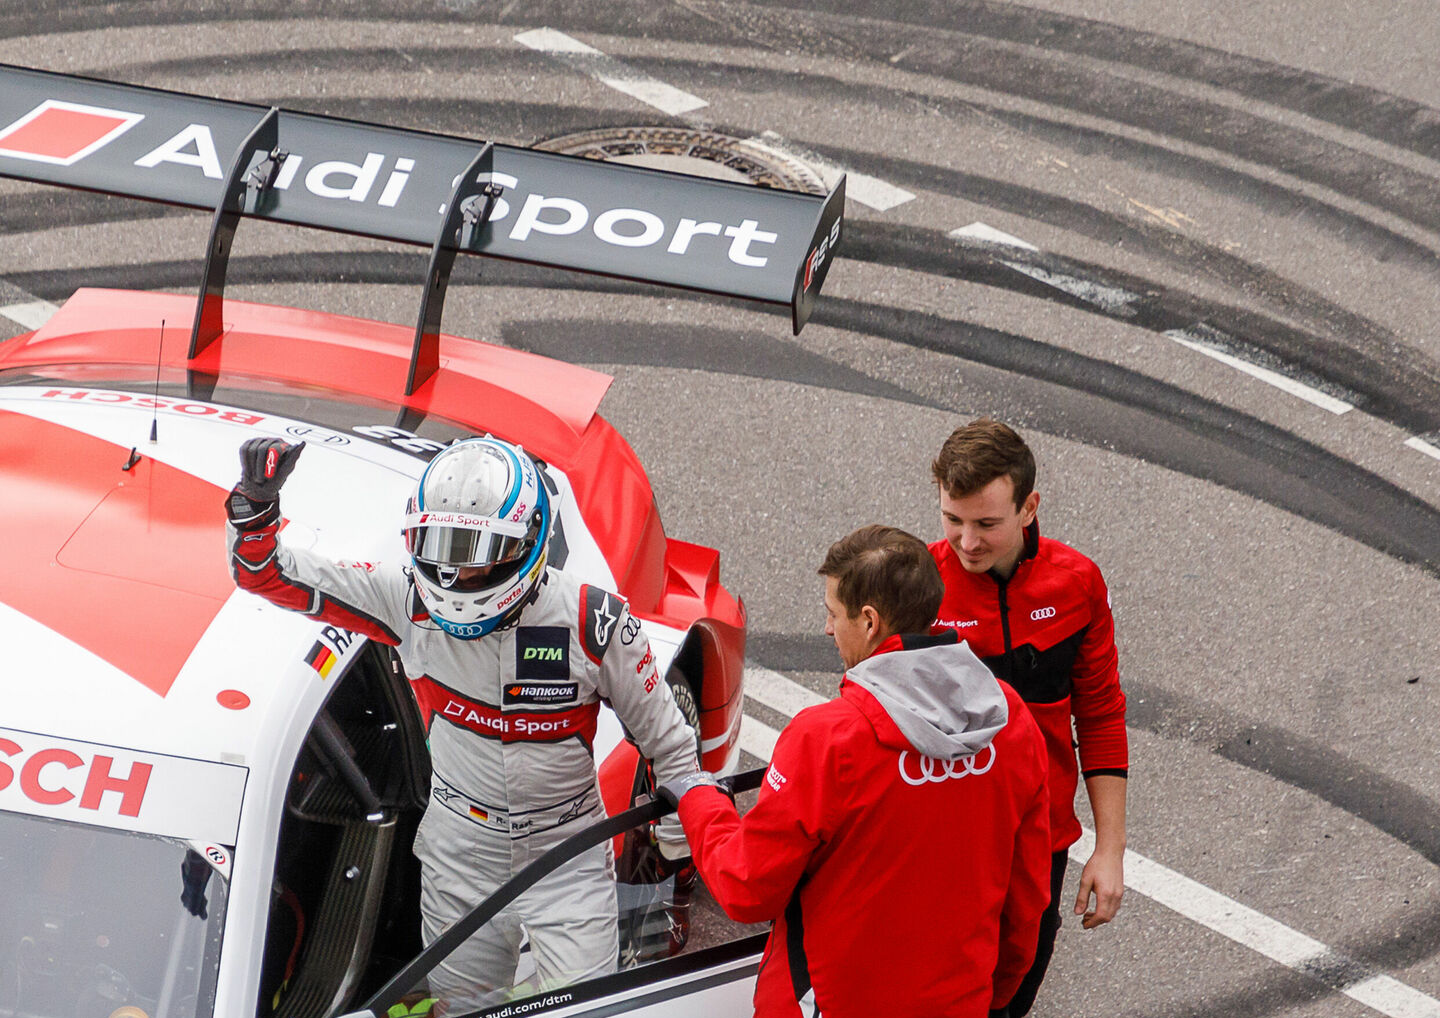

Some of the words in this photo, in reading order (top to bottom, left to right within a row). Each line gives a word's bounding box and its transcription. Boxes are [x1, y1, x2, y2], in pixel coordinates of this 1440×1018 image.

[40, 389, 266, 425] BOSCH
[429, 514, 454, 523] Audi
[457, 515, 490, 527] Sport
[523, 647, 563, 661] DTM
[465, 710, 509, 733] Audi
[514, 718, 570, 735] Sport
[511, 819, 534, 830] Rast
